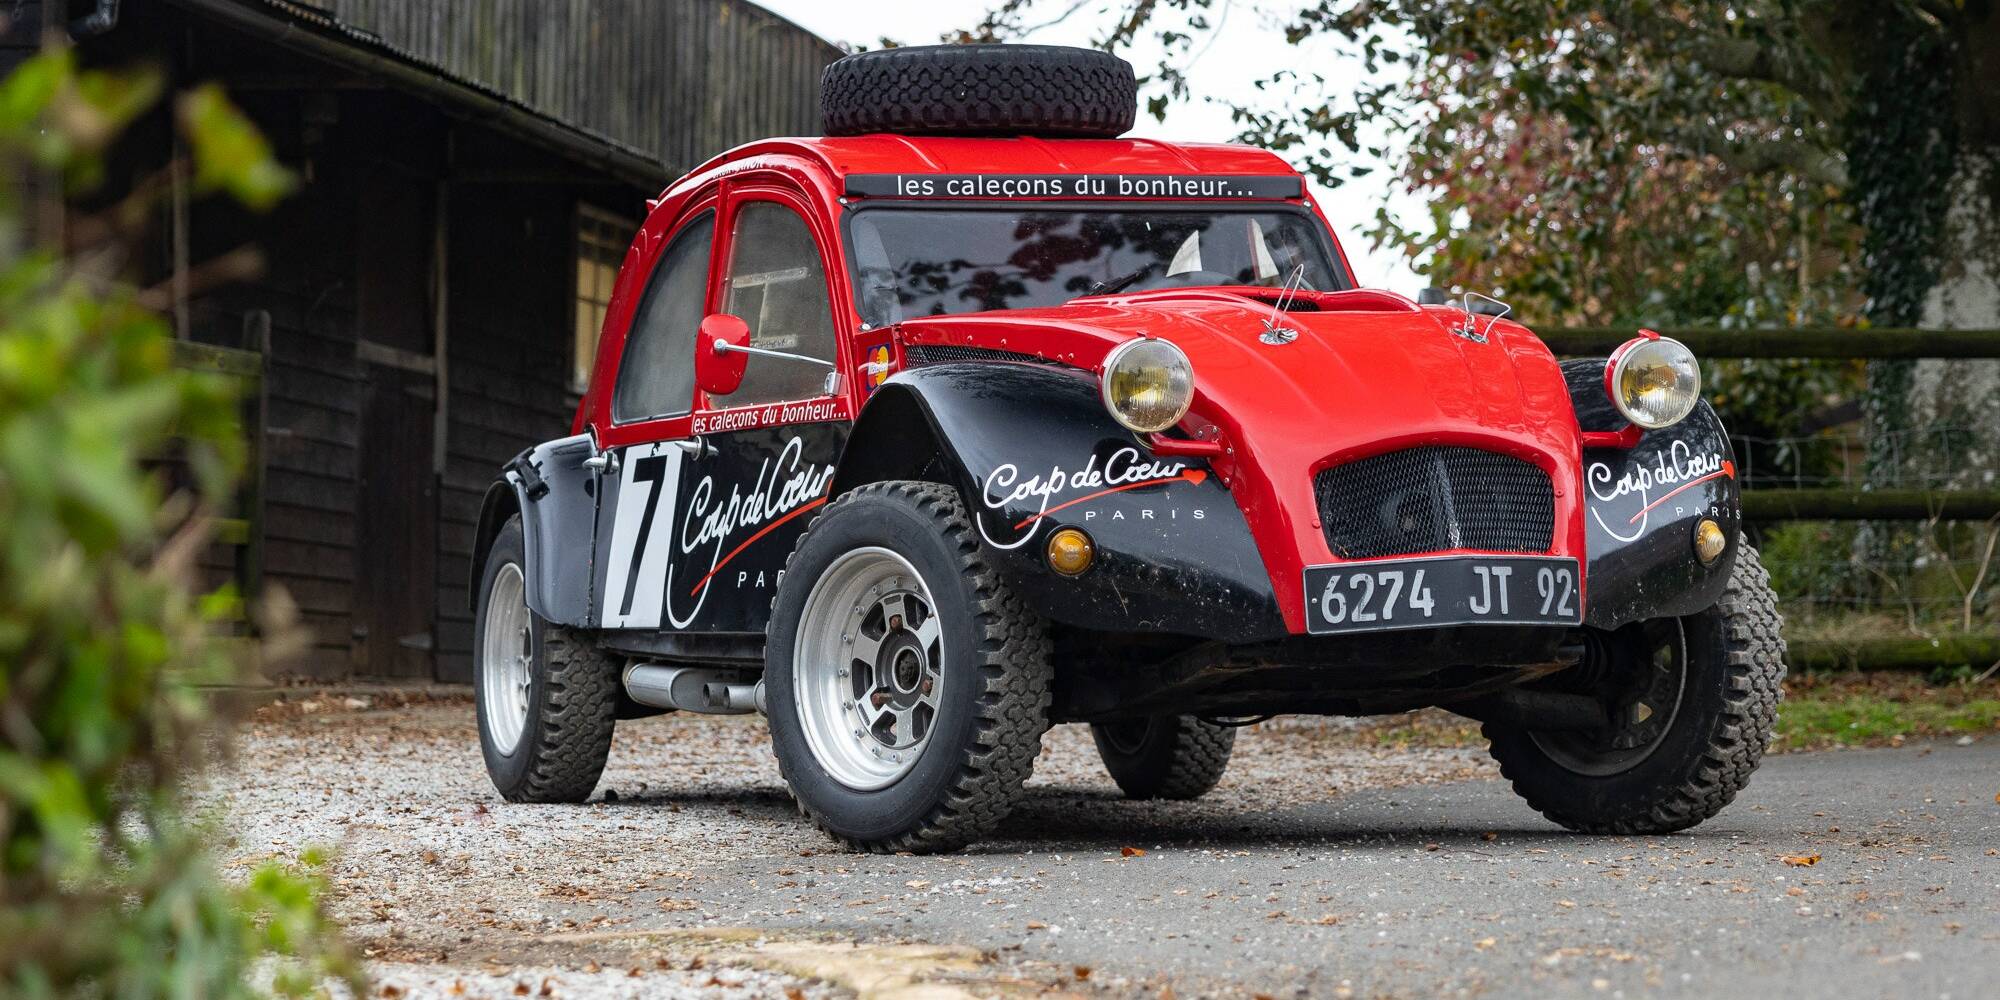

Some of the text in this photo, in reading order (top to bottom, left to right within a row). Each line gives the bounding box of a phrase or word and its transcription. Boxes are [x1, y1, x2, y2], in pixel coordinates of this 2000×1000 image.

[897, 174, 1253, 198] les caleçons du bonheur...
[691, 401, 847, 433] les caleçons du bonheur...
[739, 457, 765, 527] de
[977, 463, 1066, 549] Coup
[1070, 454, 1102, 488] de
[1085, 509, 1205, 521] PARIS
[1588, 462, 1652, 542] Coup
[1655, 450, 1678, 485] de
[1675, 506, 1741, 520] PARIS
[633, 455, 668, 616] 7
[1321, 566, 1574, 624] 6274 JT 92
